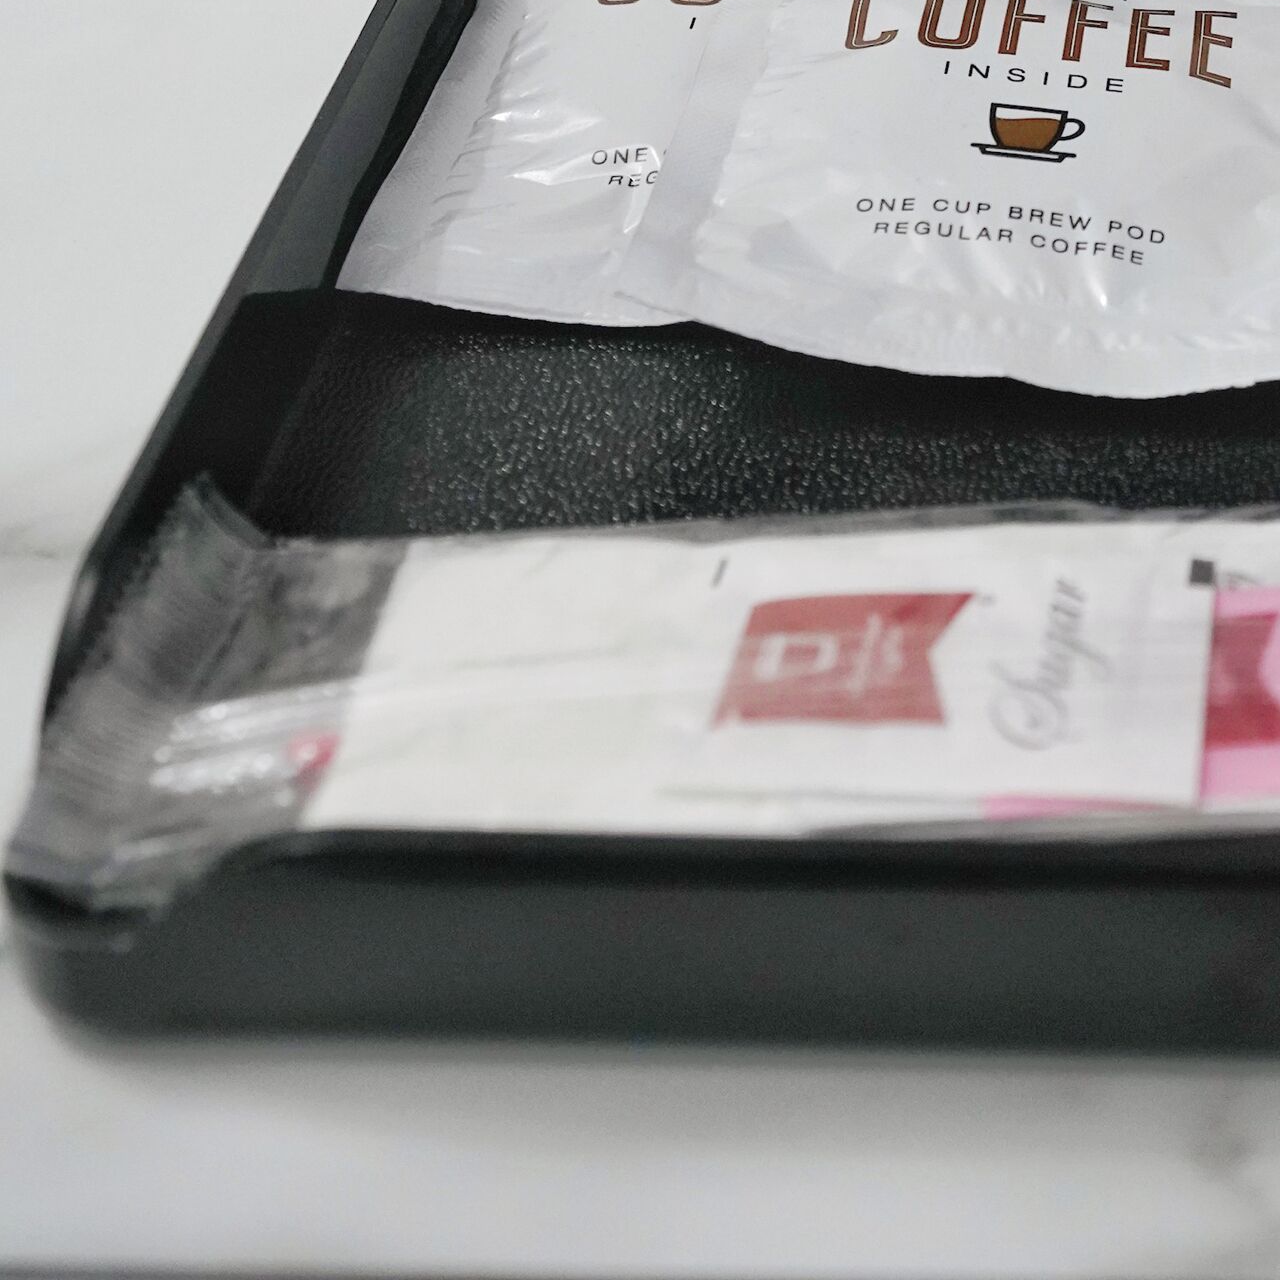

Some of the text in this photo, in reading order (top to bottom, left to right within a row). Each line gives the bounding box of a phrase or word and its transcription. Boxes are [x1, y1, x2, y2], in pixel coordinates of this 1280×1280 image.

[943, 60, 1125, 94] INSIDE
[591, 147, 649, 166] ONE
[856, 197, 1166, 245] ONE CUP BREW POD
[873, 221, 1145, 266] REGULAR COFFEE
[987, 576, 1113, 751] Sugar
